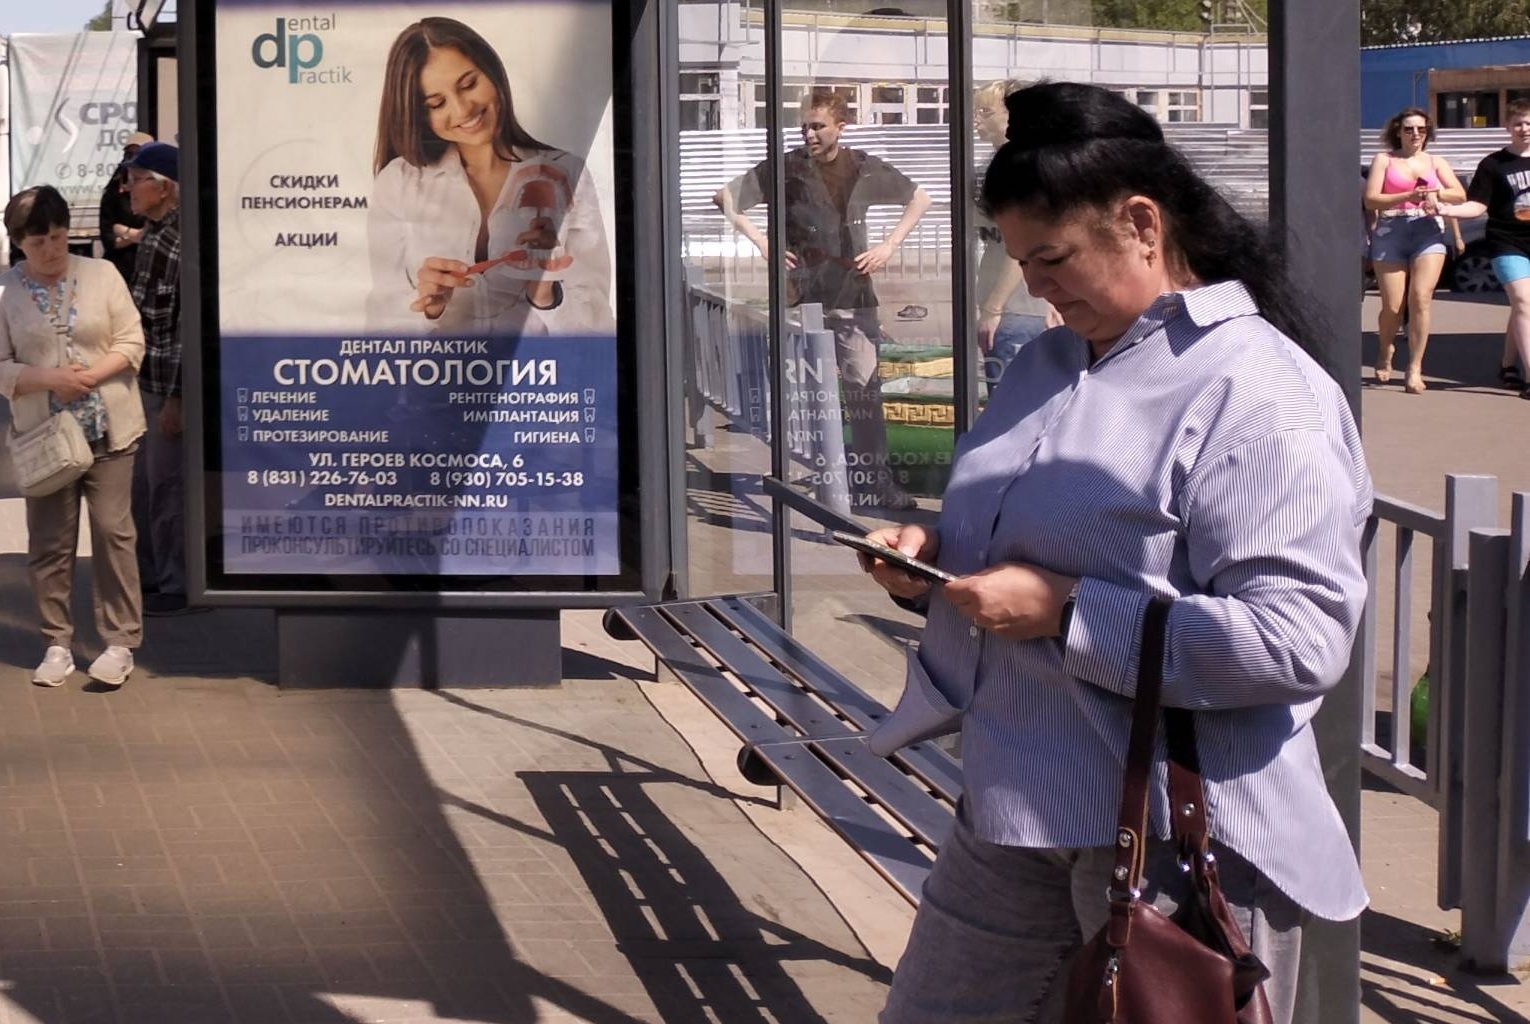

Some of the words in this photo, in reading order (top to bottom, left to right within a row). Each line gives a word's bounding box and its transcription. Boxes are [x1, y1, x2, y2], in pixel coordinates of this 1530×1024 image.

[79, 102, 137, 125] СРО
[269, 174, 339, 190] СКИДКИ
[241, 196, 369, 209] ПЕНСИОНЕРАМ
[274, 232, 338, 249] АКЦИИ
[339, 339, 405, 356] ДЕНТАЛ
[410, 340, 489, 355] ПРАКТИК
[273, 358, 558, 386] СТОМАТОЛОГИЯ
[251, 391, 318, 404] ЛЕЧЕНИЕ
[448, 392, 579, 405] РЕНТГЕНОГРАФИЯ
[252, 409, 330, 423] УДАЛЕНИЕ
[463, 410, 580, 425] ИМПЛАНТАЦИЯ
[253, 430, 390, 443] ПРОТЕЗИРОВАНИЕ
[513, 431, 581, 444] ГИГИЕНА
[309, 453, 338, 467] УЛ.
[342, 453, 405, 467] ГЕРОЕВ
[410, 453, 509, 470] КОСМОСА,
[512, 453, 525, 468] 6
[247, 471, 259, 485] 8
[263, 469, 306, 487] (831)
[309, 471, 398, 485] 226-76-03
[429, 471, 441, 485] 8
[445, 471, 491, 488] (930)
[495, 472, 584, 486] 705-15-38
[325, 493, 508, 508] DENTALPRACTIK-NN.RU
[241, 516, 346, 534] ИМЕЮТСЯ
[441, 538, 460, 556] СО
[465, 538, 595, 557] СПЕЦИАЛИСТОМ
